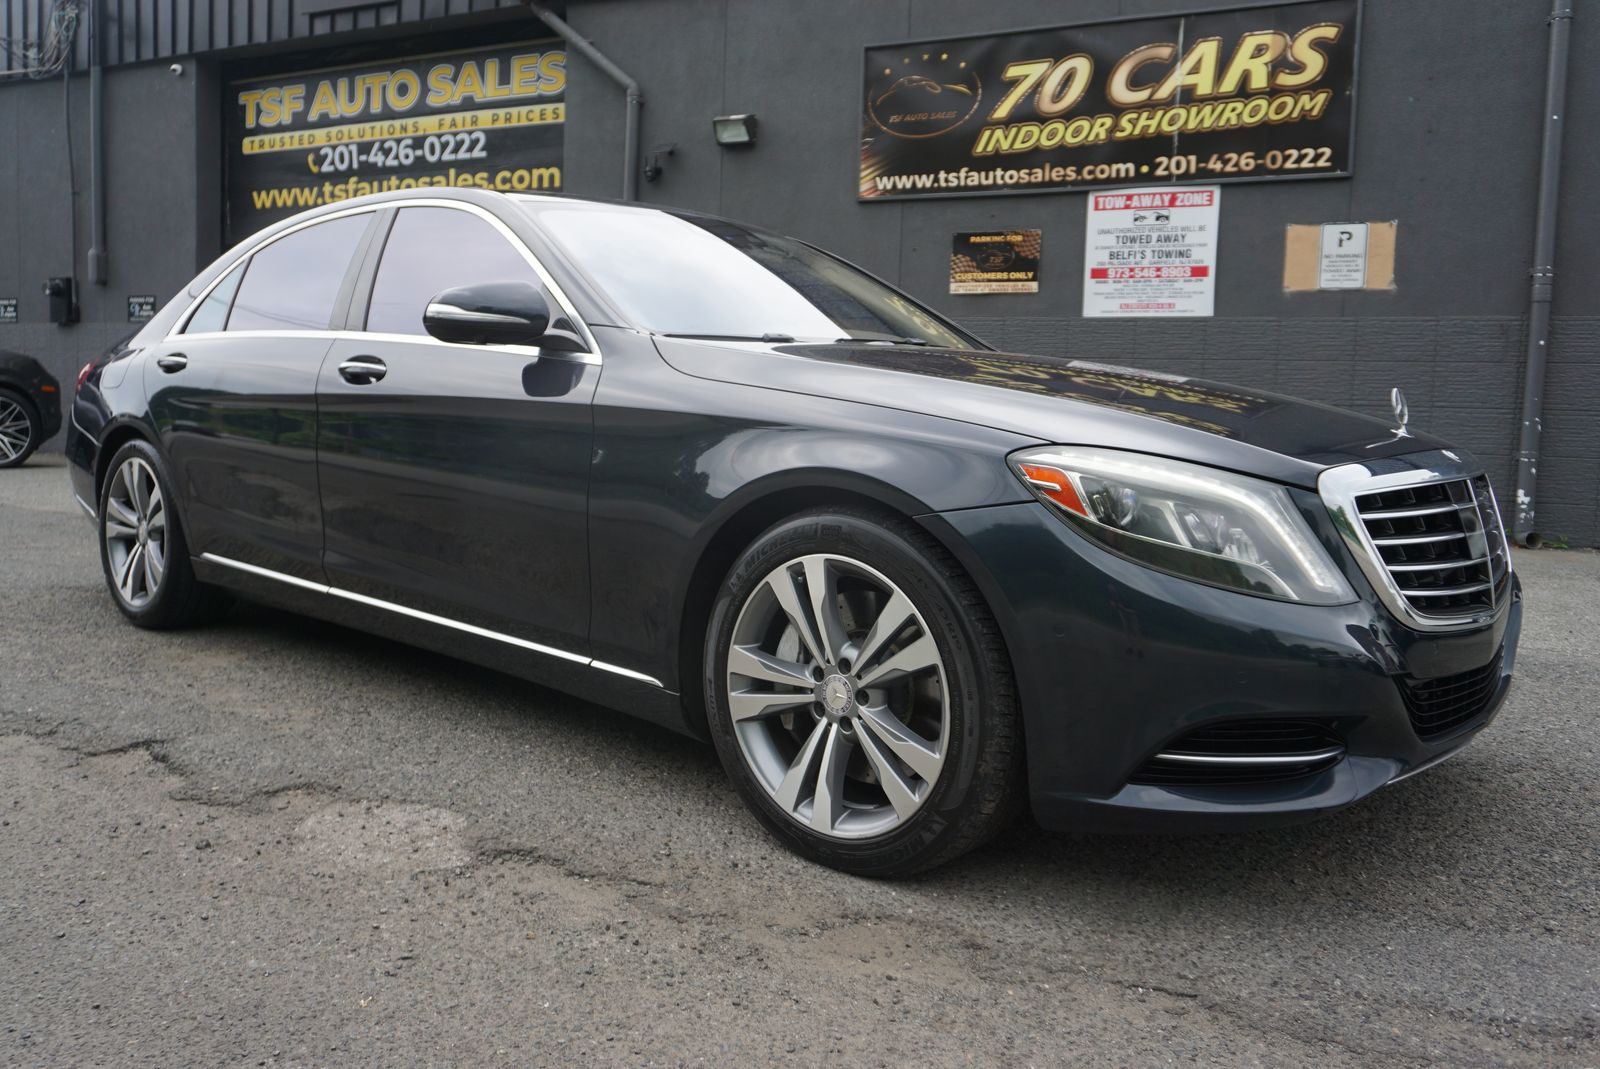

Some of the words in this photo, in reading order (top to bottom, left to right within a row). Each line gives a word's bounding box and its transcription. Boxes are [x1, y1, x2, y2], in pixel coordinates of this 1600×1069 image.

[239, 84, 304, 128] TSF
[307, 69, 421, 122] AUTO
[426, 51, 567, 107] SALES
[988, 53, 1095, 122] 70
[1106, 22, 1345, 106] CARS
[250, 133, 316, 151] TRUSTED
[325, 121, 427, 143] SOLUTIONS,
[439, 114, 479, 130] FAIR
[491, 107, 561, 126] PRICES
[973, 115, 1113, 157] INDOOR
[1114, 90, 1332, 141] SHOWROOM
[319, 131, 487, 173] 201-426-0222
[875, 162, 1135, 190] www.tsfautosales.com
[1154, 146, 1333, 177] 201-426-0222
[1097, 193, 1171, 209] TOW-AWAY
[1175, 191, 1210, 206] ZONE
[1109, 250, 1147, 260] BELFI'S
[1151, 249, 1192, 259] TOWING
[1115, 234, 1151, 244] TOWED
[1155, 233, 1187, 243] AWAY
[955, 272, 1008, 280] CUSTOMERS
[1009, 271, 1034, 279] ONLY
